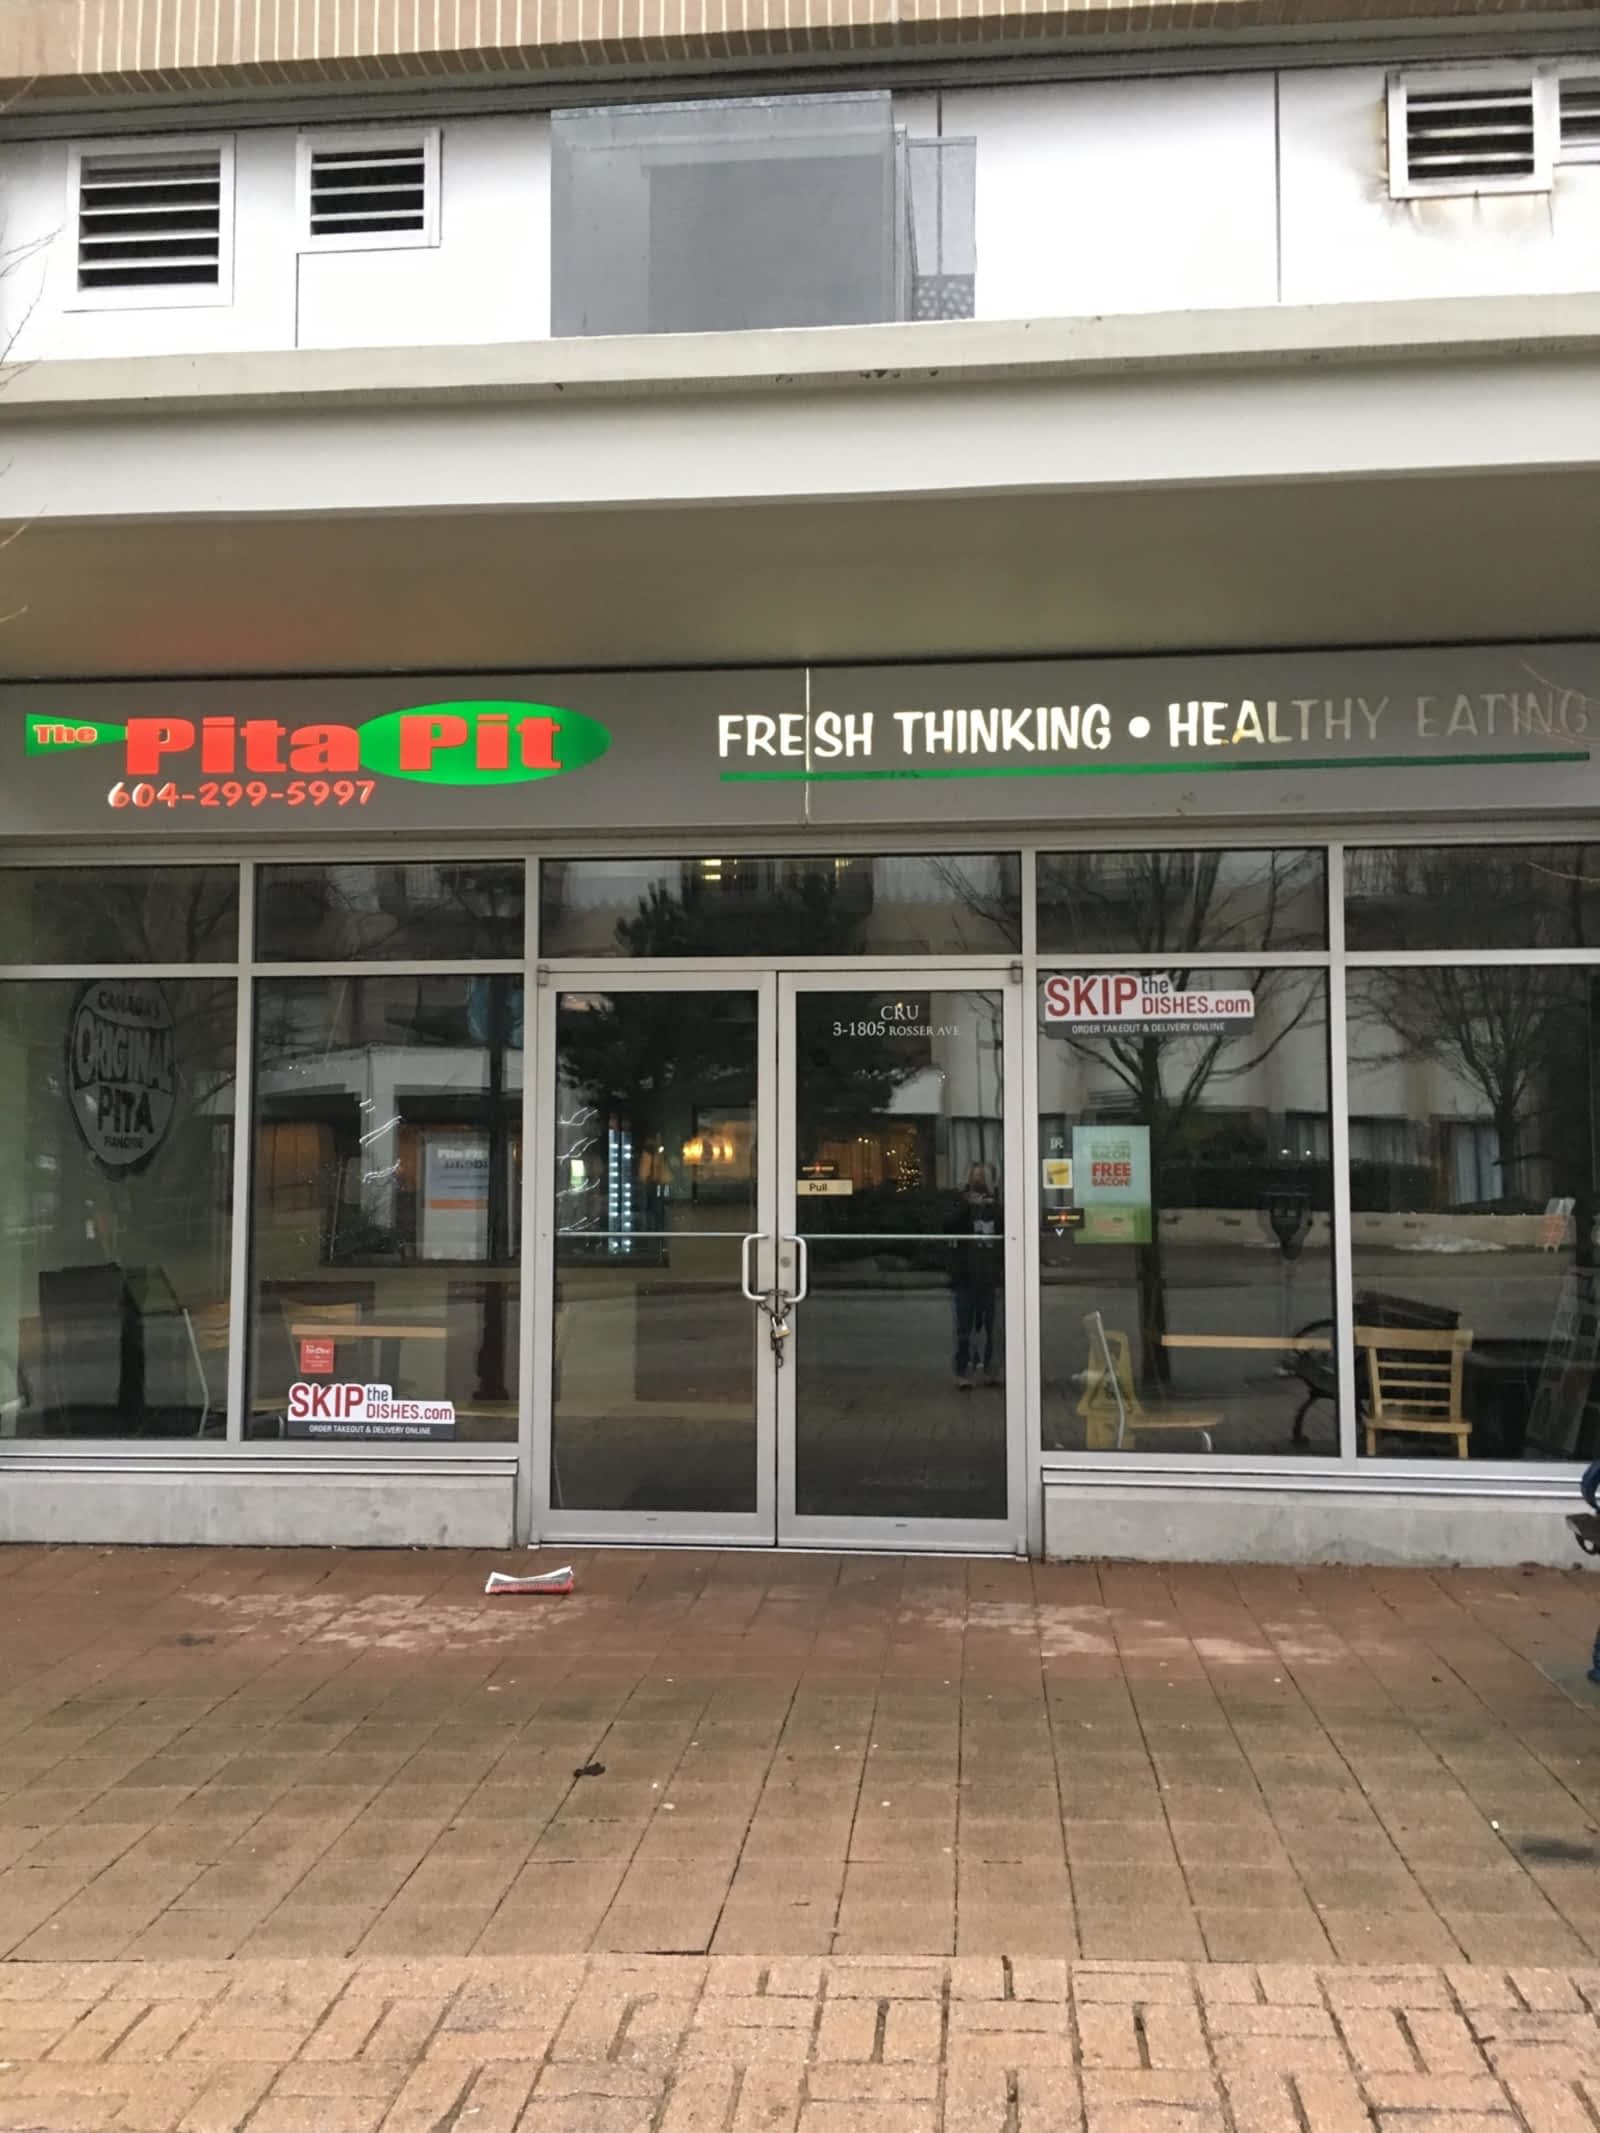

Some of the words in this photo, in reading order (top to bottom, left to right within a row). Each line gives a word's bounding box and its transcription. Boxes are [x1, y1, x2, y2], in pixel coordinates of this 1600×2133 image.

[718, 710, 874, 758] FRESH
[893, 704, 1111, 755] THINKING
[1168, 697, 1390, 748] HEALTHY
[1416, 691, 1589, 737] EATING
[33, 723, 98, 744] The
[125, 715, 360, 776] Pita
[399, 713, 563, 771] Pit
[107, 779, 376, 809] 604-299-5997
[1142, 978, 1169, 994] the
[1047, 977, 1138, 1017] SKIP
[1142, 995, 1250, 1015] DISHES.com
[880, 1004, 919, 1020] CRU
[832, 1021, 886, 1037] 3-1805
[889, 1025, 935, 1037] ROSSER
[1072, 1024, 1100, 1034] ORDER
[1102, 1024, 1140, 1033] TAKEOUT
[1151, 1023, 1191, 1032] DELIVERY
[1192, 1022, 1225, 1031] ONLINE
[97, 1086, 154, 1134] PITA
[1091, 1162, 1132, 1177] FREE
[809, 1183, 828, 1192] Pull
[290, 1384, 365, 1418] SKIP
[367, 1386, 389, 1401] the
[366, 1403, 452, 1421] DISHES.com
[309, 1424, 333, 1433] ORDER
[333, 1425, 364, 1433] TAKEOUT
[372, 1425, 404, 1434] DELIVERY
[405, 1426, 431, 1435] ONLINE
